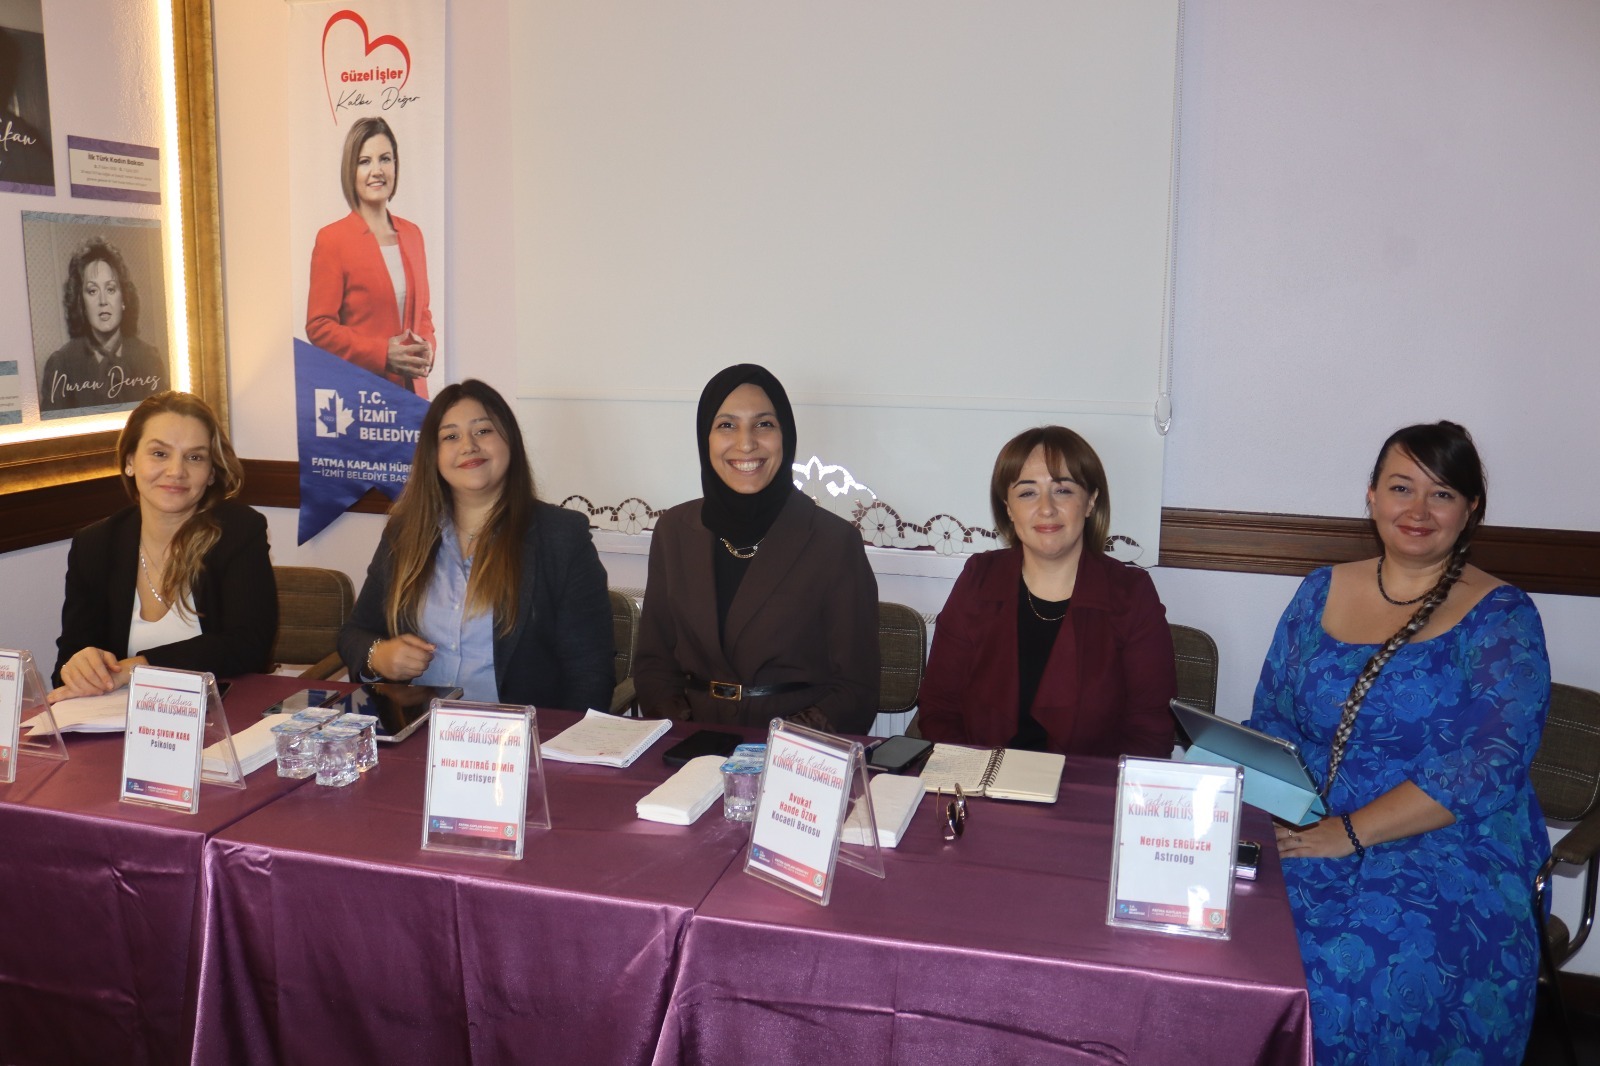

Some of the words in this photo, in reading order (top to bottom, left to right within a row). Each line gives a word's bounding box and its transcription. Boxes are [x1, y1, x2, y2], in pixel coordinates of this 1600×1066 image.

[341, 69, 374, 82] Güzel
[376, 66, 404, 84] İşler
[336, 90, 372, 112] Kalbe
[381, 86, 420, 111] Değer
[96, 154, 109, 162] Türk
[51, 370, 104, 403] Nuran
[358, 390, 386, 405] T.C.
[359, 405, 398, 424] İZMİT
[311, 457, 345, 469] FATMA
[347, 460, 387, 472] KAPLAN
[321, 467, 345, 478] İZMİT
[347, 471, 388, 482] BELEDİYE
[447, 720, 476, 733] Kadın
[479, 721, 510, 734] Kadın
[440, 729, 465, 743] KONAK
[150, 739, 176, 752] Psikolog
[441, 758, 458, 768] Hilal
[460, 760, 490, 771] KATIRAĞ
[491, 762, 515, 773] DMİR
[780, 746, 805, 764] Kadın
[806, 754, 838, 775] Kadına
[772, 754, 795, 773] KONAK
[795, 763, 844, 791] BULUŞMALARI
[788, 792, 812, 809] Avukat
[779, 801, 800, 817] Hande
[1128, 803, 1160, 818] KONAK
[1163, 806, 1229, 824] BULUŞARI
[771, 810, 796, 828] Kocaeli
[796, 820, 821, 838] Barosu
[1139, 836, 1170, 848] Nergis
[1154, 851, 1195, 866] Astrolog
